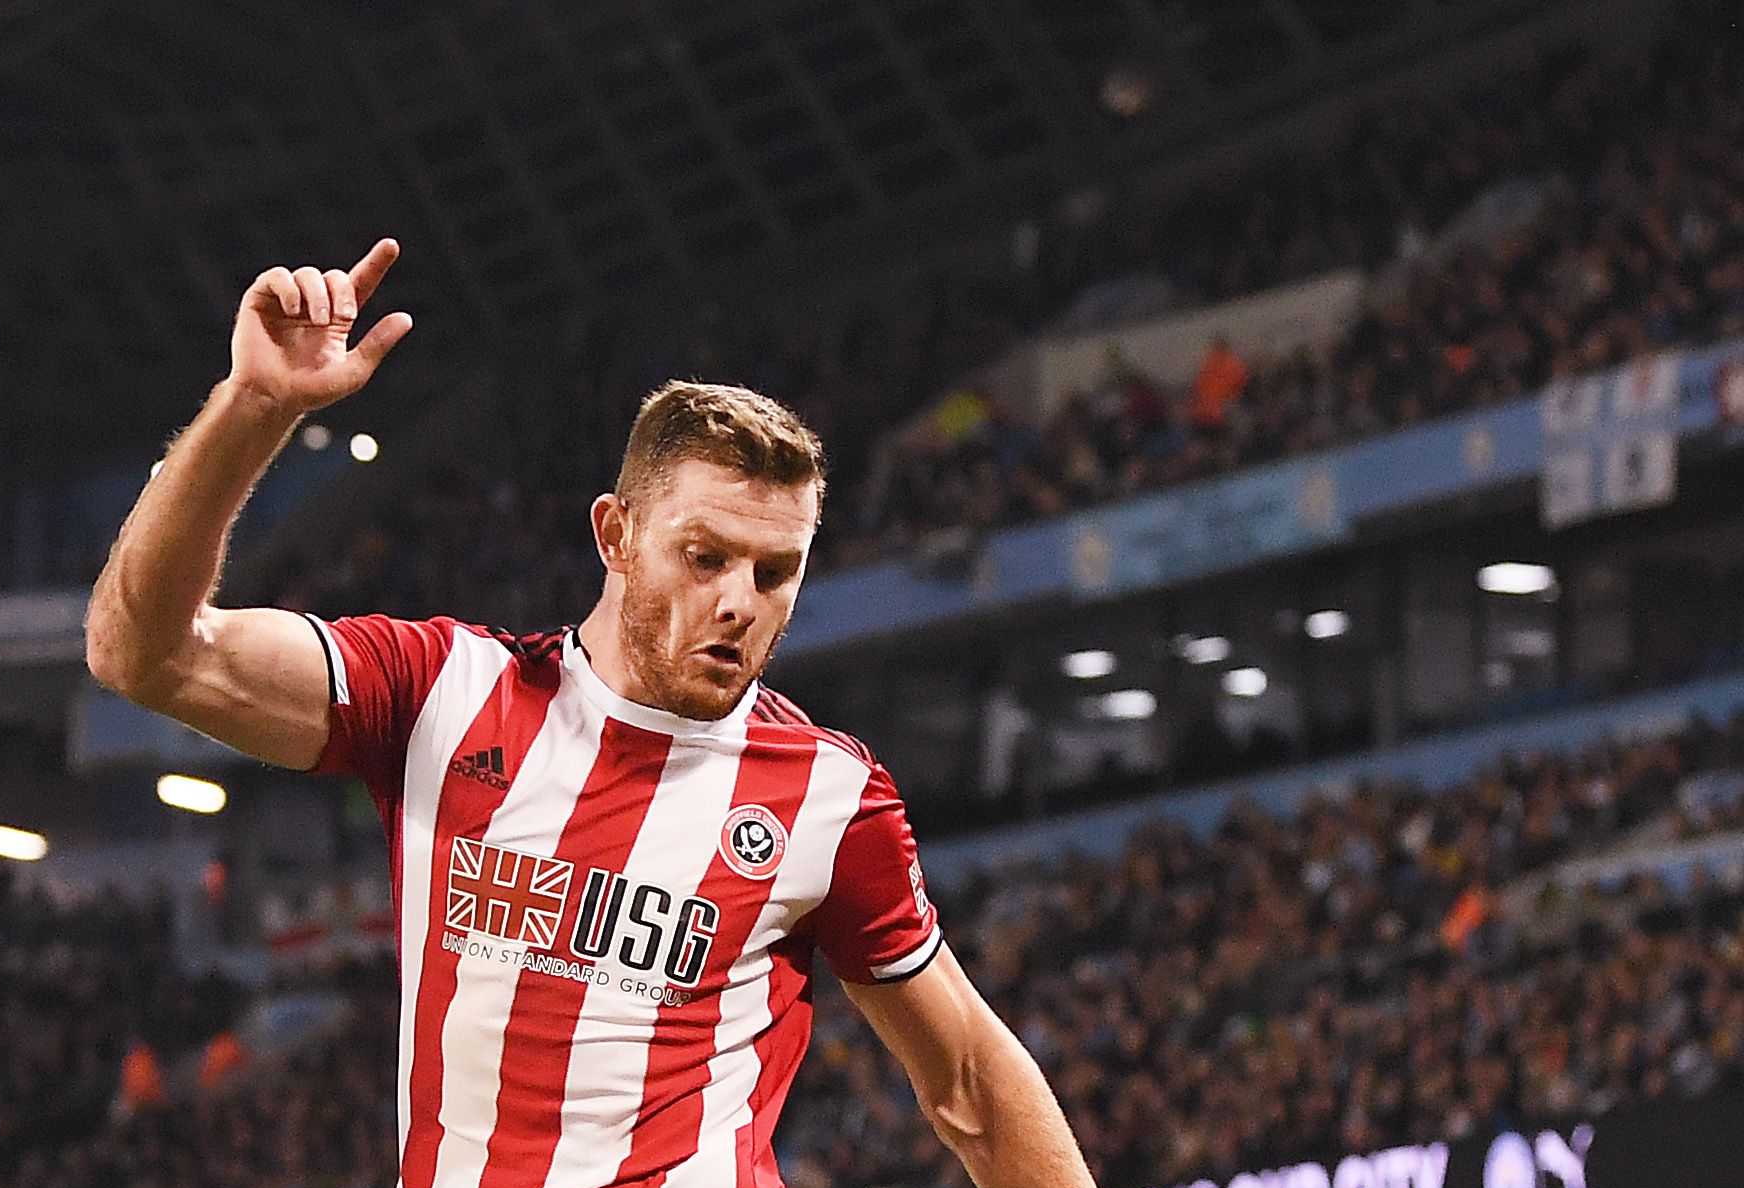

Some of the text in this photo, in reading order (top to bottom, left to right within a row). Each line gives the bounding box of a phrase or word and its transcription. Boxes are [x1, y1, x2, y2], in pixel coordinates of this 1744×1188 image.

[451, 760, 509, 791] adidas
[571, 869, 719, 987] USG
[442, 930, 493, 961] UNION
[499, 948, 610, 986] STANDARD
